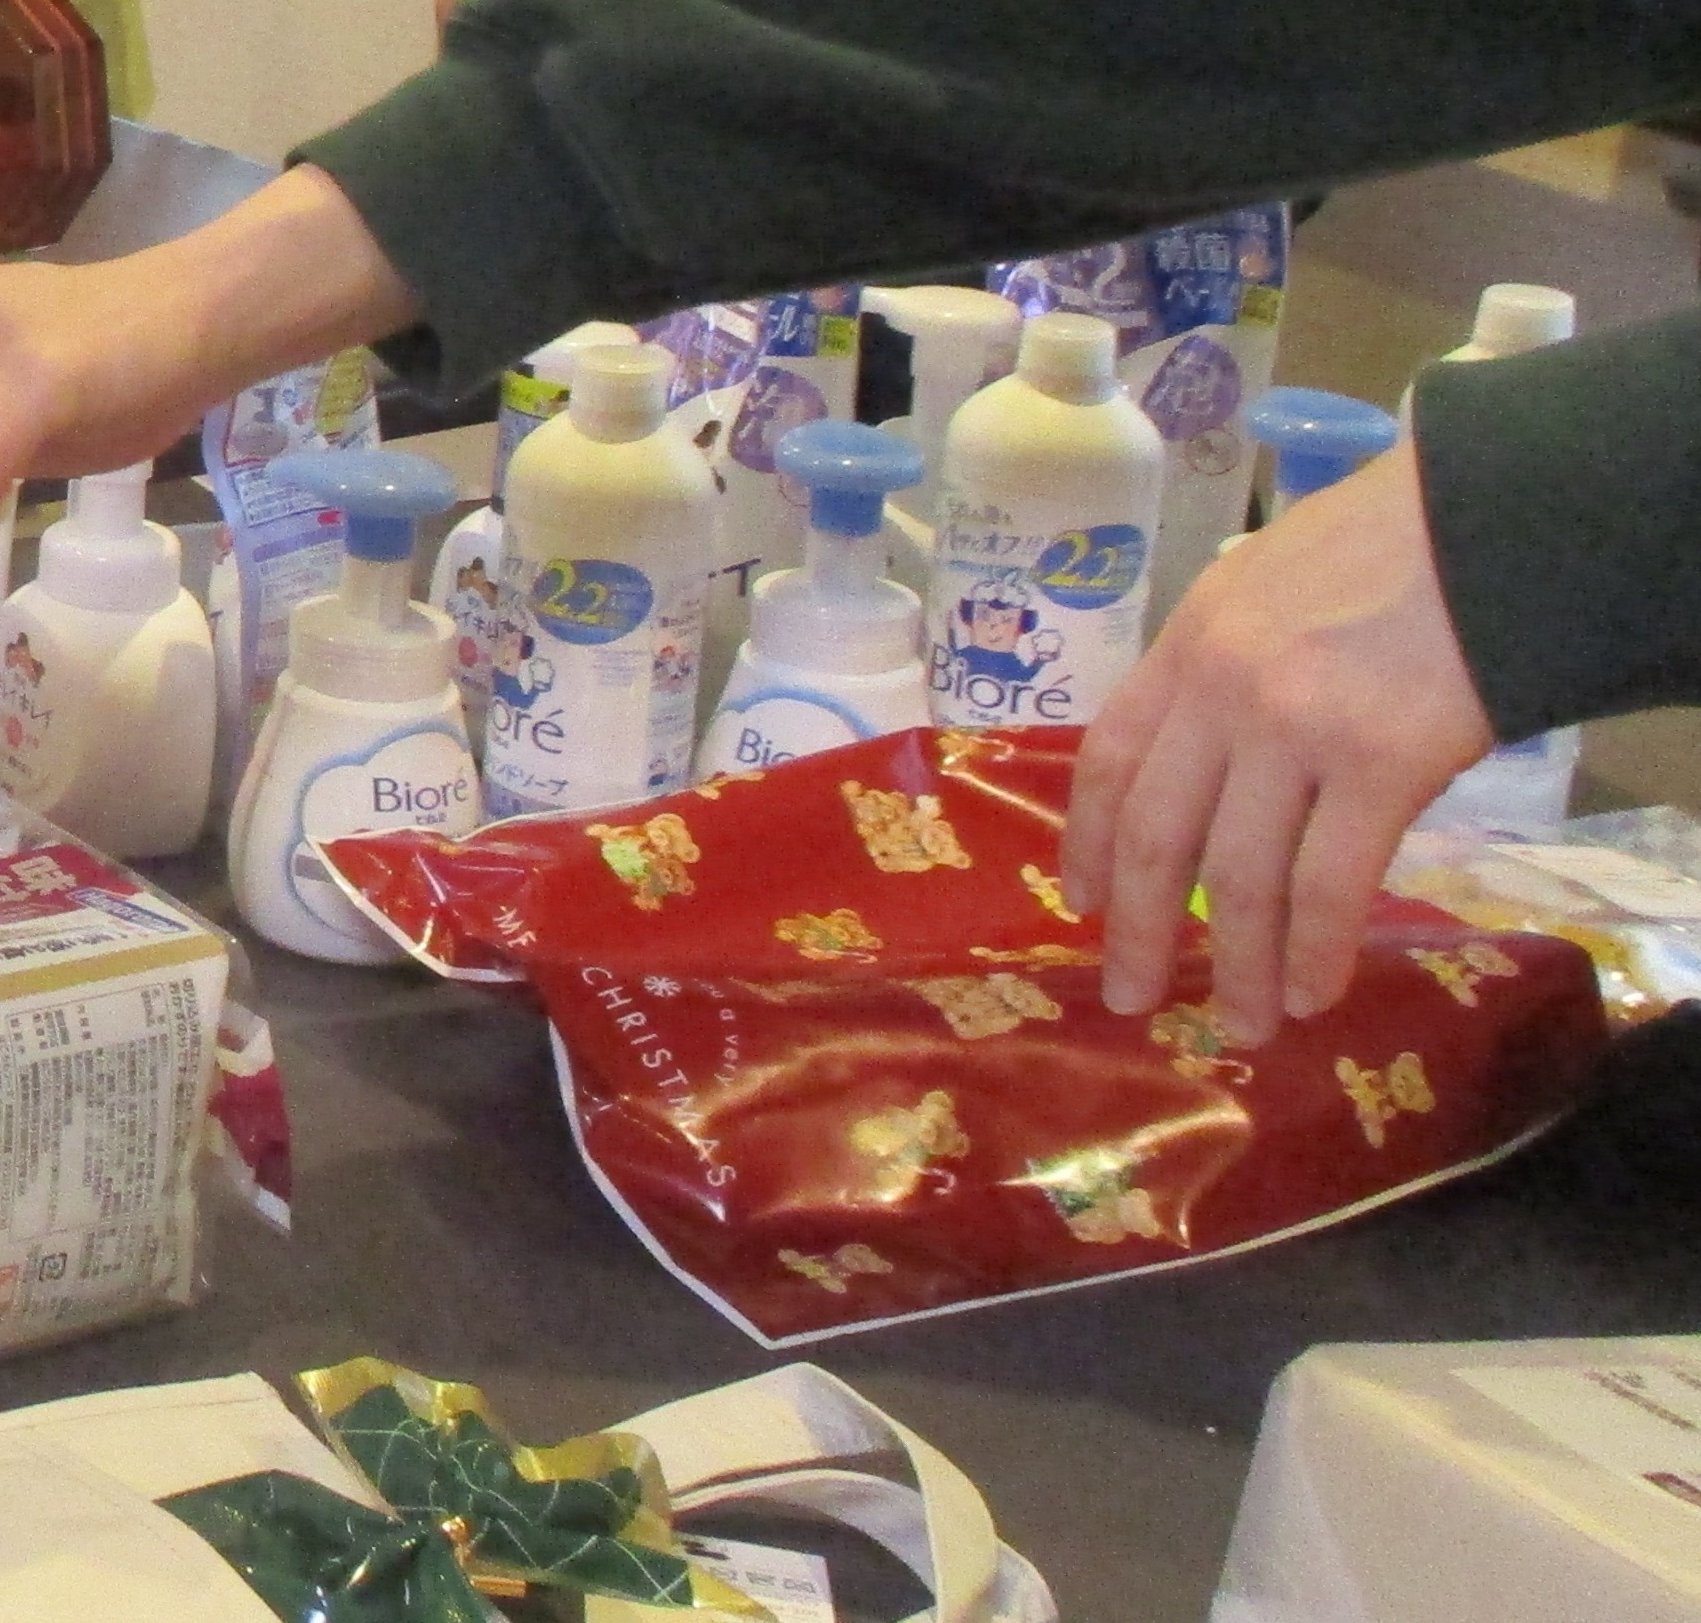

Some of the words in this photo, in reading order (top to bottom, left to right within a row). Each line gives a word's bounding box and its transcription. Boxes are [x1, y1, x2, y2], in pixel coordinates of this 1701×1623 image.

[929, 643, 1074, 720] Bioré
[492, 695, 565, 755] oré
[372, 766, 469, 814] Bioré
[582, 965, 738, 1188] CHRISTMAS
